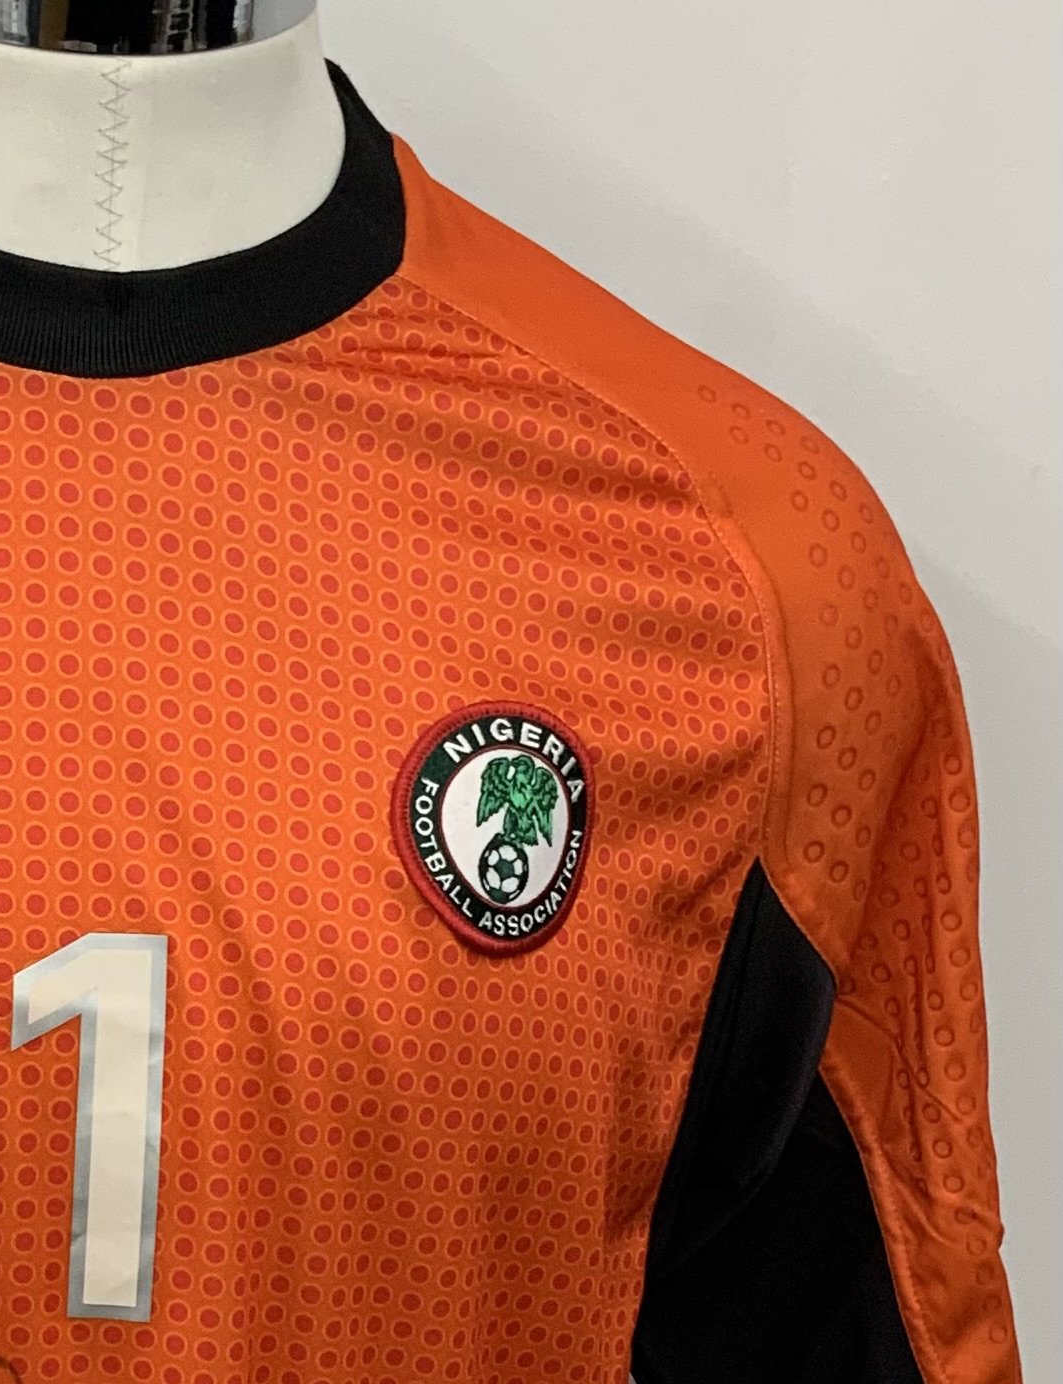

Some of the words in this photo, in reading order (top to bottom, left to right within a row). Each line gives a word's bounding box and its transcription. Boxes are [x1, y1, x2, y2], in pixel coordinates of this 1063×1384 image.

[442, 717, 585, 804] NIGERIA
[414, 777, 474, 918] FOOTBALL
[477, 830, 583, 936] ASSOCIATION
[10, 931, 169, 1323] 1
